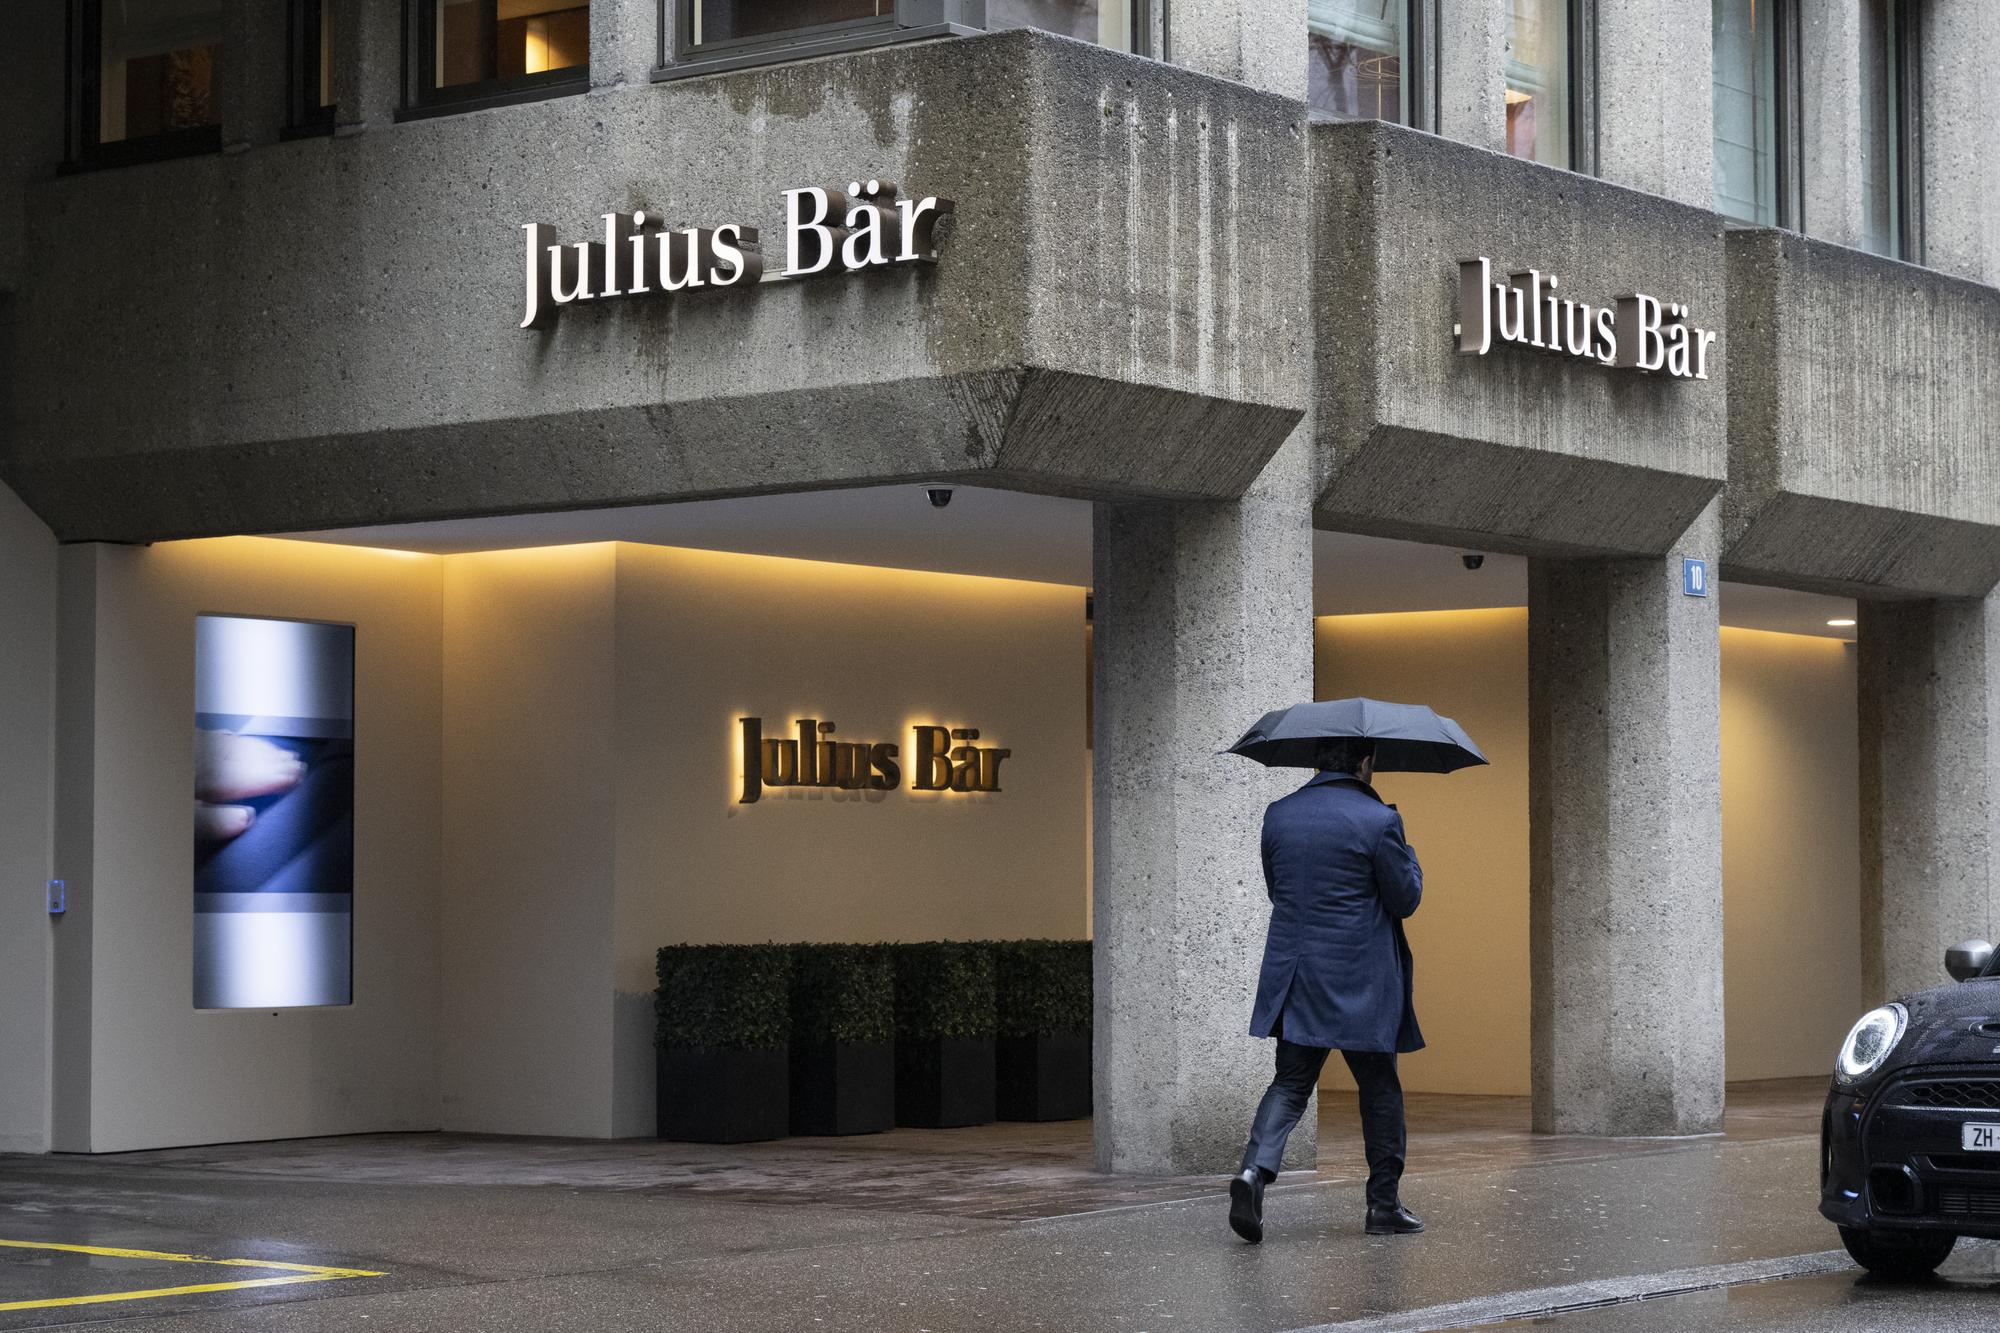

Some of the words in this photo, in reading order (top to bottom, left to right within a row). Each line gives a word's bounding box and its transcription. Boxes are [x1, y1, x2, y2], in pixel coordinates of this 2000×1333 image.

[520, 210, 747, 329] Julius
[780, 179, 937, 277] Bär
[1478, 256, 1617, 362] Julius
[1635, 293, 1716, 379] Bär
[1690, 565, 1703, 590] 10
[738, 717, 900, 804] Julius
[912, 725, 1011, 792] Bär
[1973, 1127, 1993, 1147] ZH
